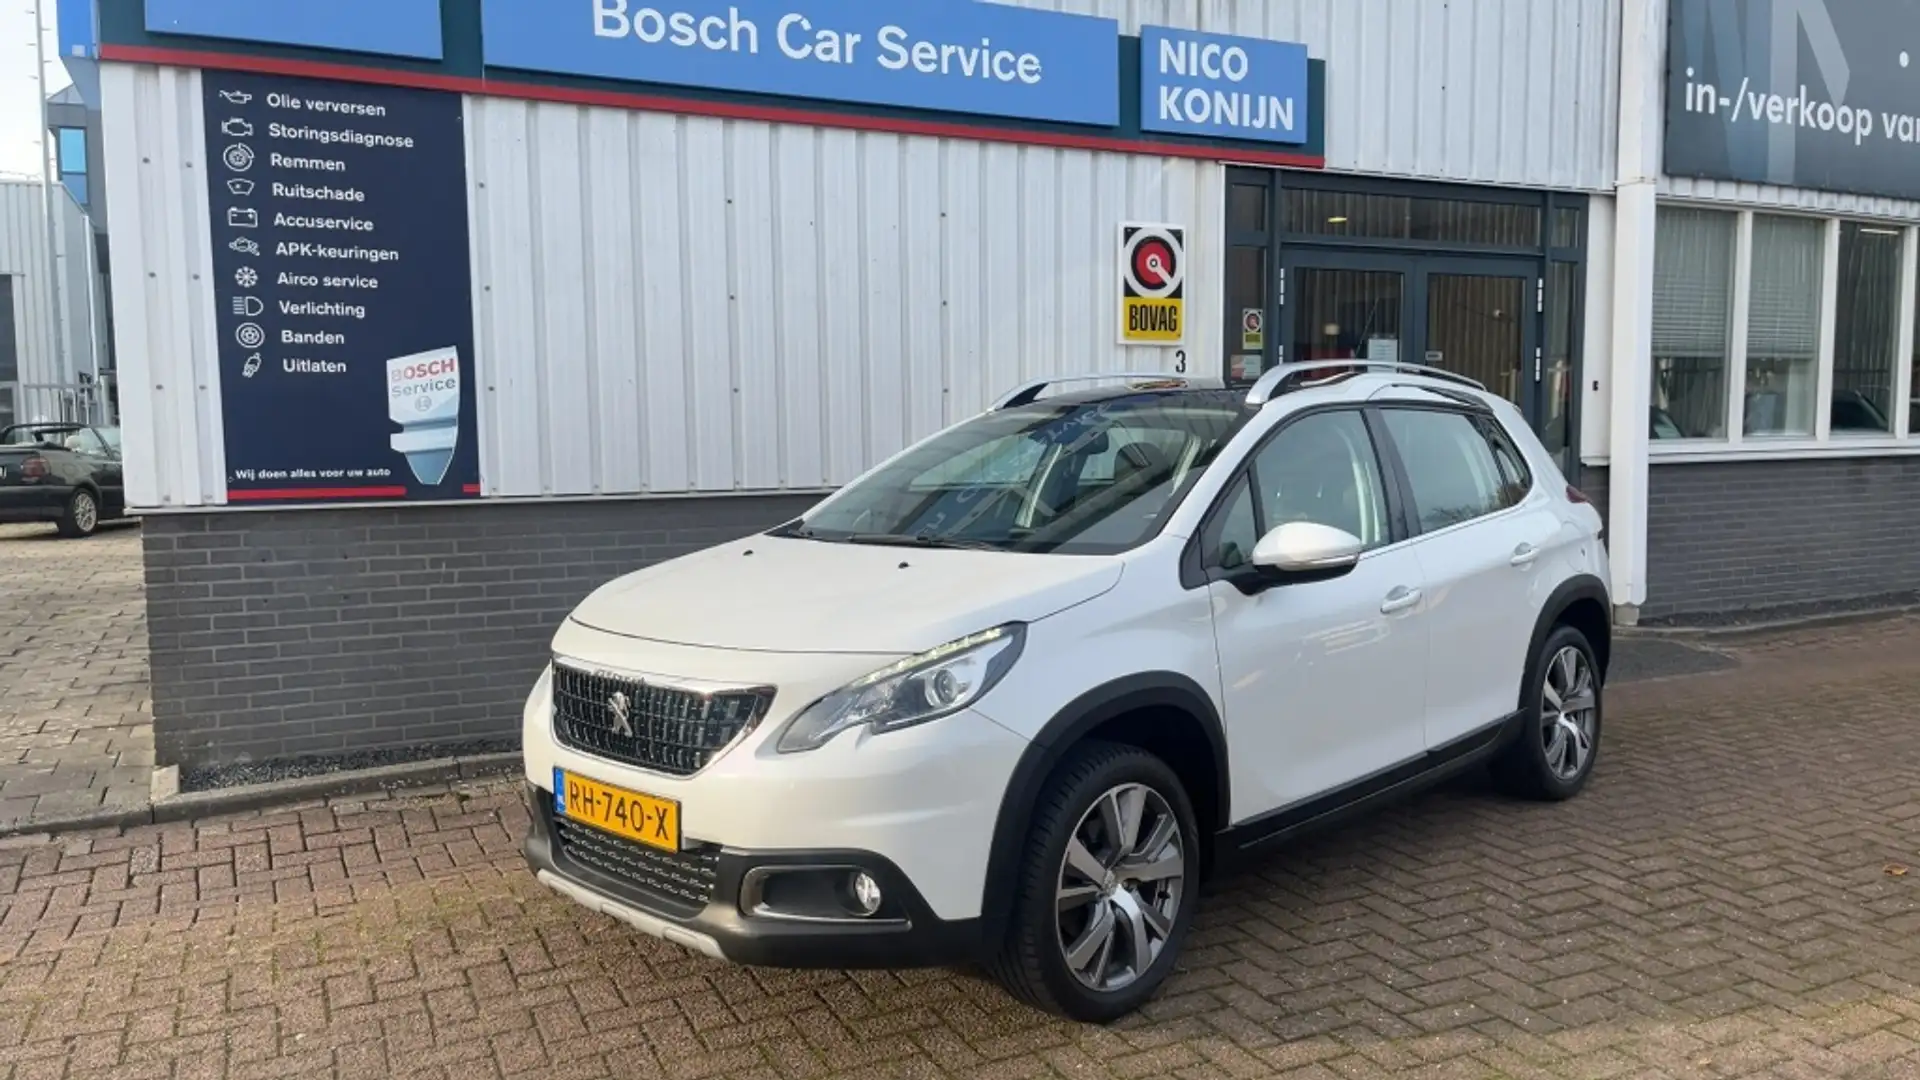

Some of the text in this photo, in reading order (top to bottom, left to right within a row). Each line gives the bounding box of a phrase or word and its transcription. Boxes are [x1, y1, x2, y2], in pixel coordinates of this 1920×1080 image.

[593, 0, 1041, 84] Bosch Car Service
[1160, 38, 1249, 82] NICO
[267, 92, 386, 117] Olie verversen
[1160, 85, 1293, 131] KONIJN
[1686, 66, 1920, 146] in-/verkoop va
[269, 122, 414, 148] Storingsdiagnose
[270, 152, 346, 172] Remmen
[272, 182, 365, 202] Ruitschade
[274, 212, 374, 232] Accuservice
[276, 241, 399, 263] APK-keuringen
[277, 271, 379, 289] Airco service
[279, 299, 366, 319] Verlichting
[1129, 304, 1177, 332] BOVAG
[281, 329, 345, 345] Banden
[283, 358, 347, 373] Uitlaten
[391, 358, 455, 382] BOSCH
[1175, 350, 1186, 373] 3
[391, 377, 456, 399] Service
[235, 468, 391, 481] Wij doen alles voor uw auto
[569, 780, 669, 841] RH-740-X
